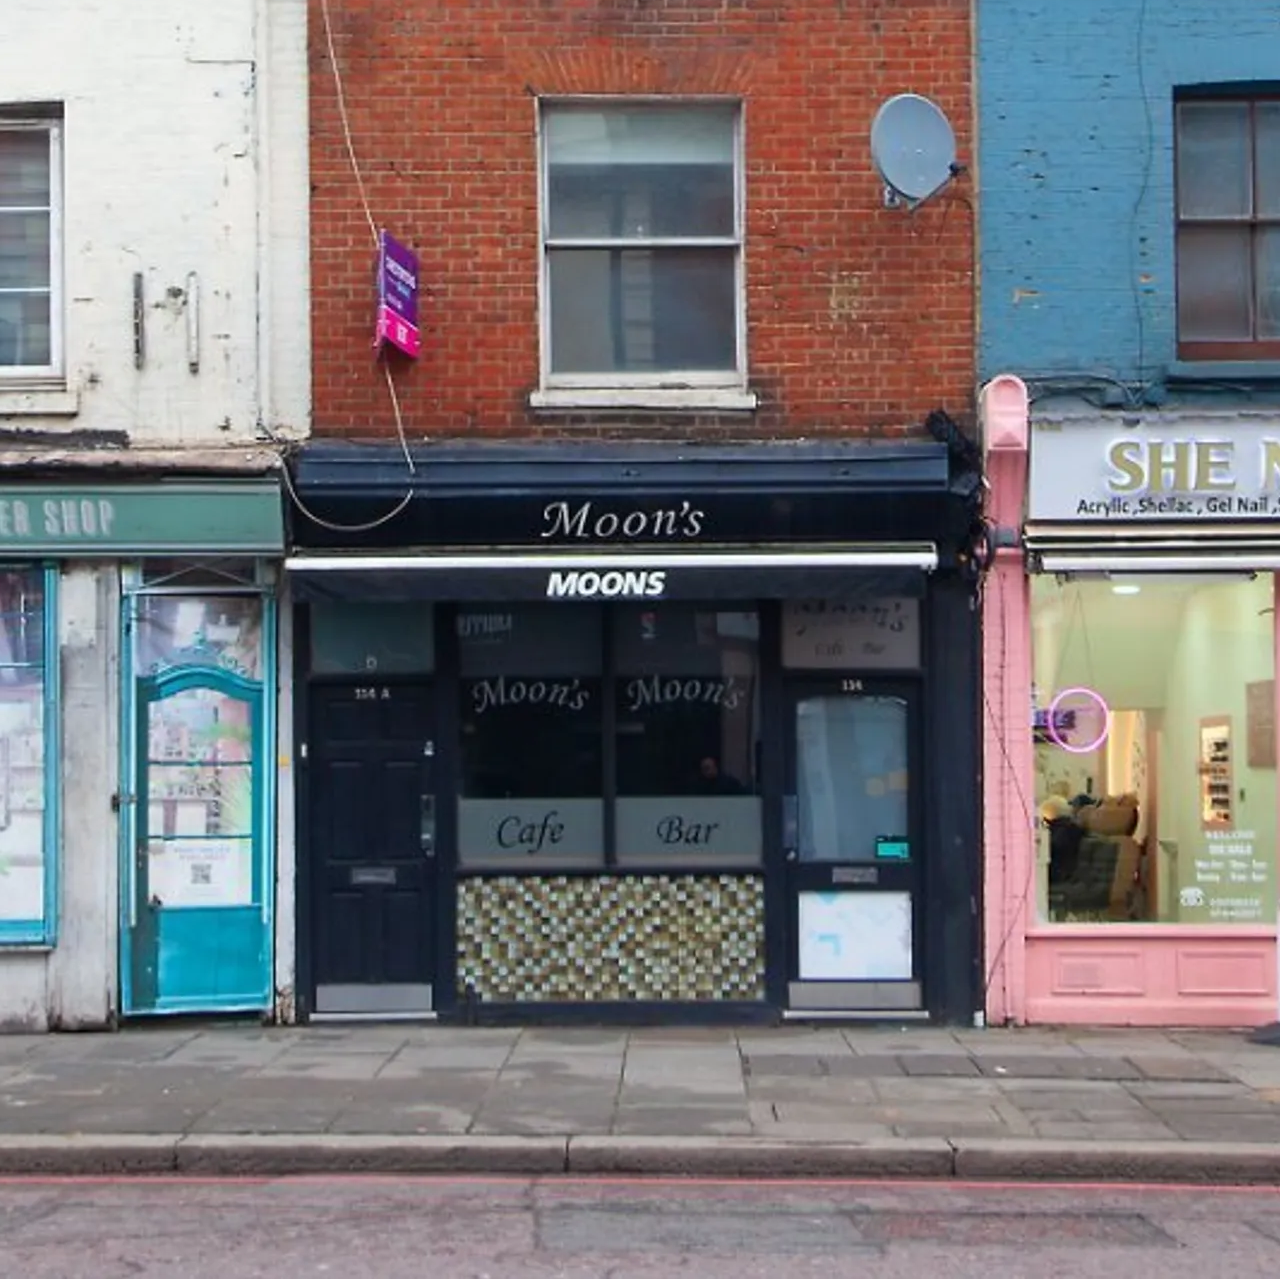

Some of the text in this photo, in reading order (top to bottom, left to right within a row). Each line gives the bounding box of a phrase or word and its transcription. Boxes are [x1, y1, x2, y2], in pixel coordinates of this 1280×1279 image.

[1107, 440, 1237, 493] SHE
[42, 499, 114, 537] SHOP
[540, 501, 705, 538] Moon's
[1077, 499, 1129, 516] Acrylic
[1206, 497, 1231, 513] Gel
[1237, 497, 1268, 513] Nail
[546, 571, 667, 597] MOONS
[472, 675, 590, 713] Moon's
[627, 675, 745, 711] Moon's
[495, 811, 565, 853] Cafe
[656, 815, 719, 845] Bar
